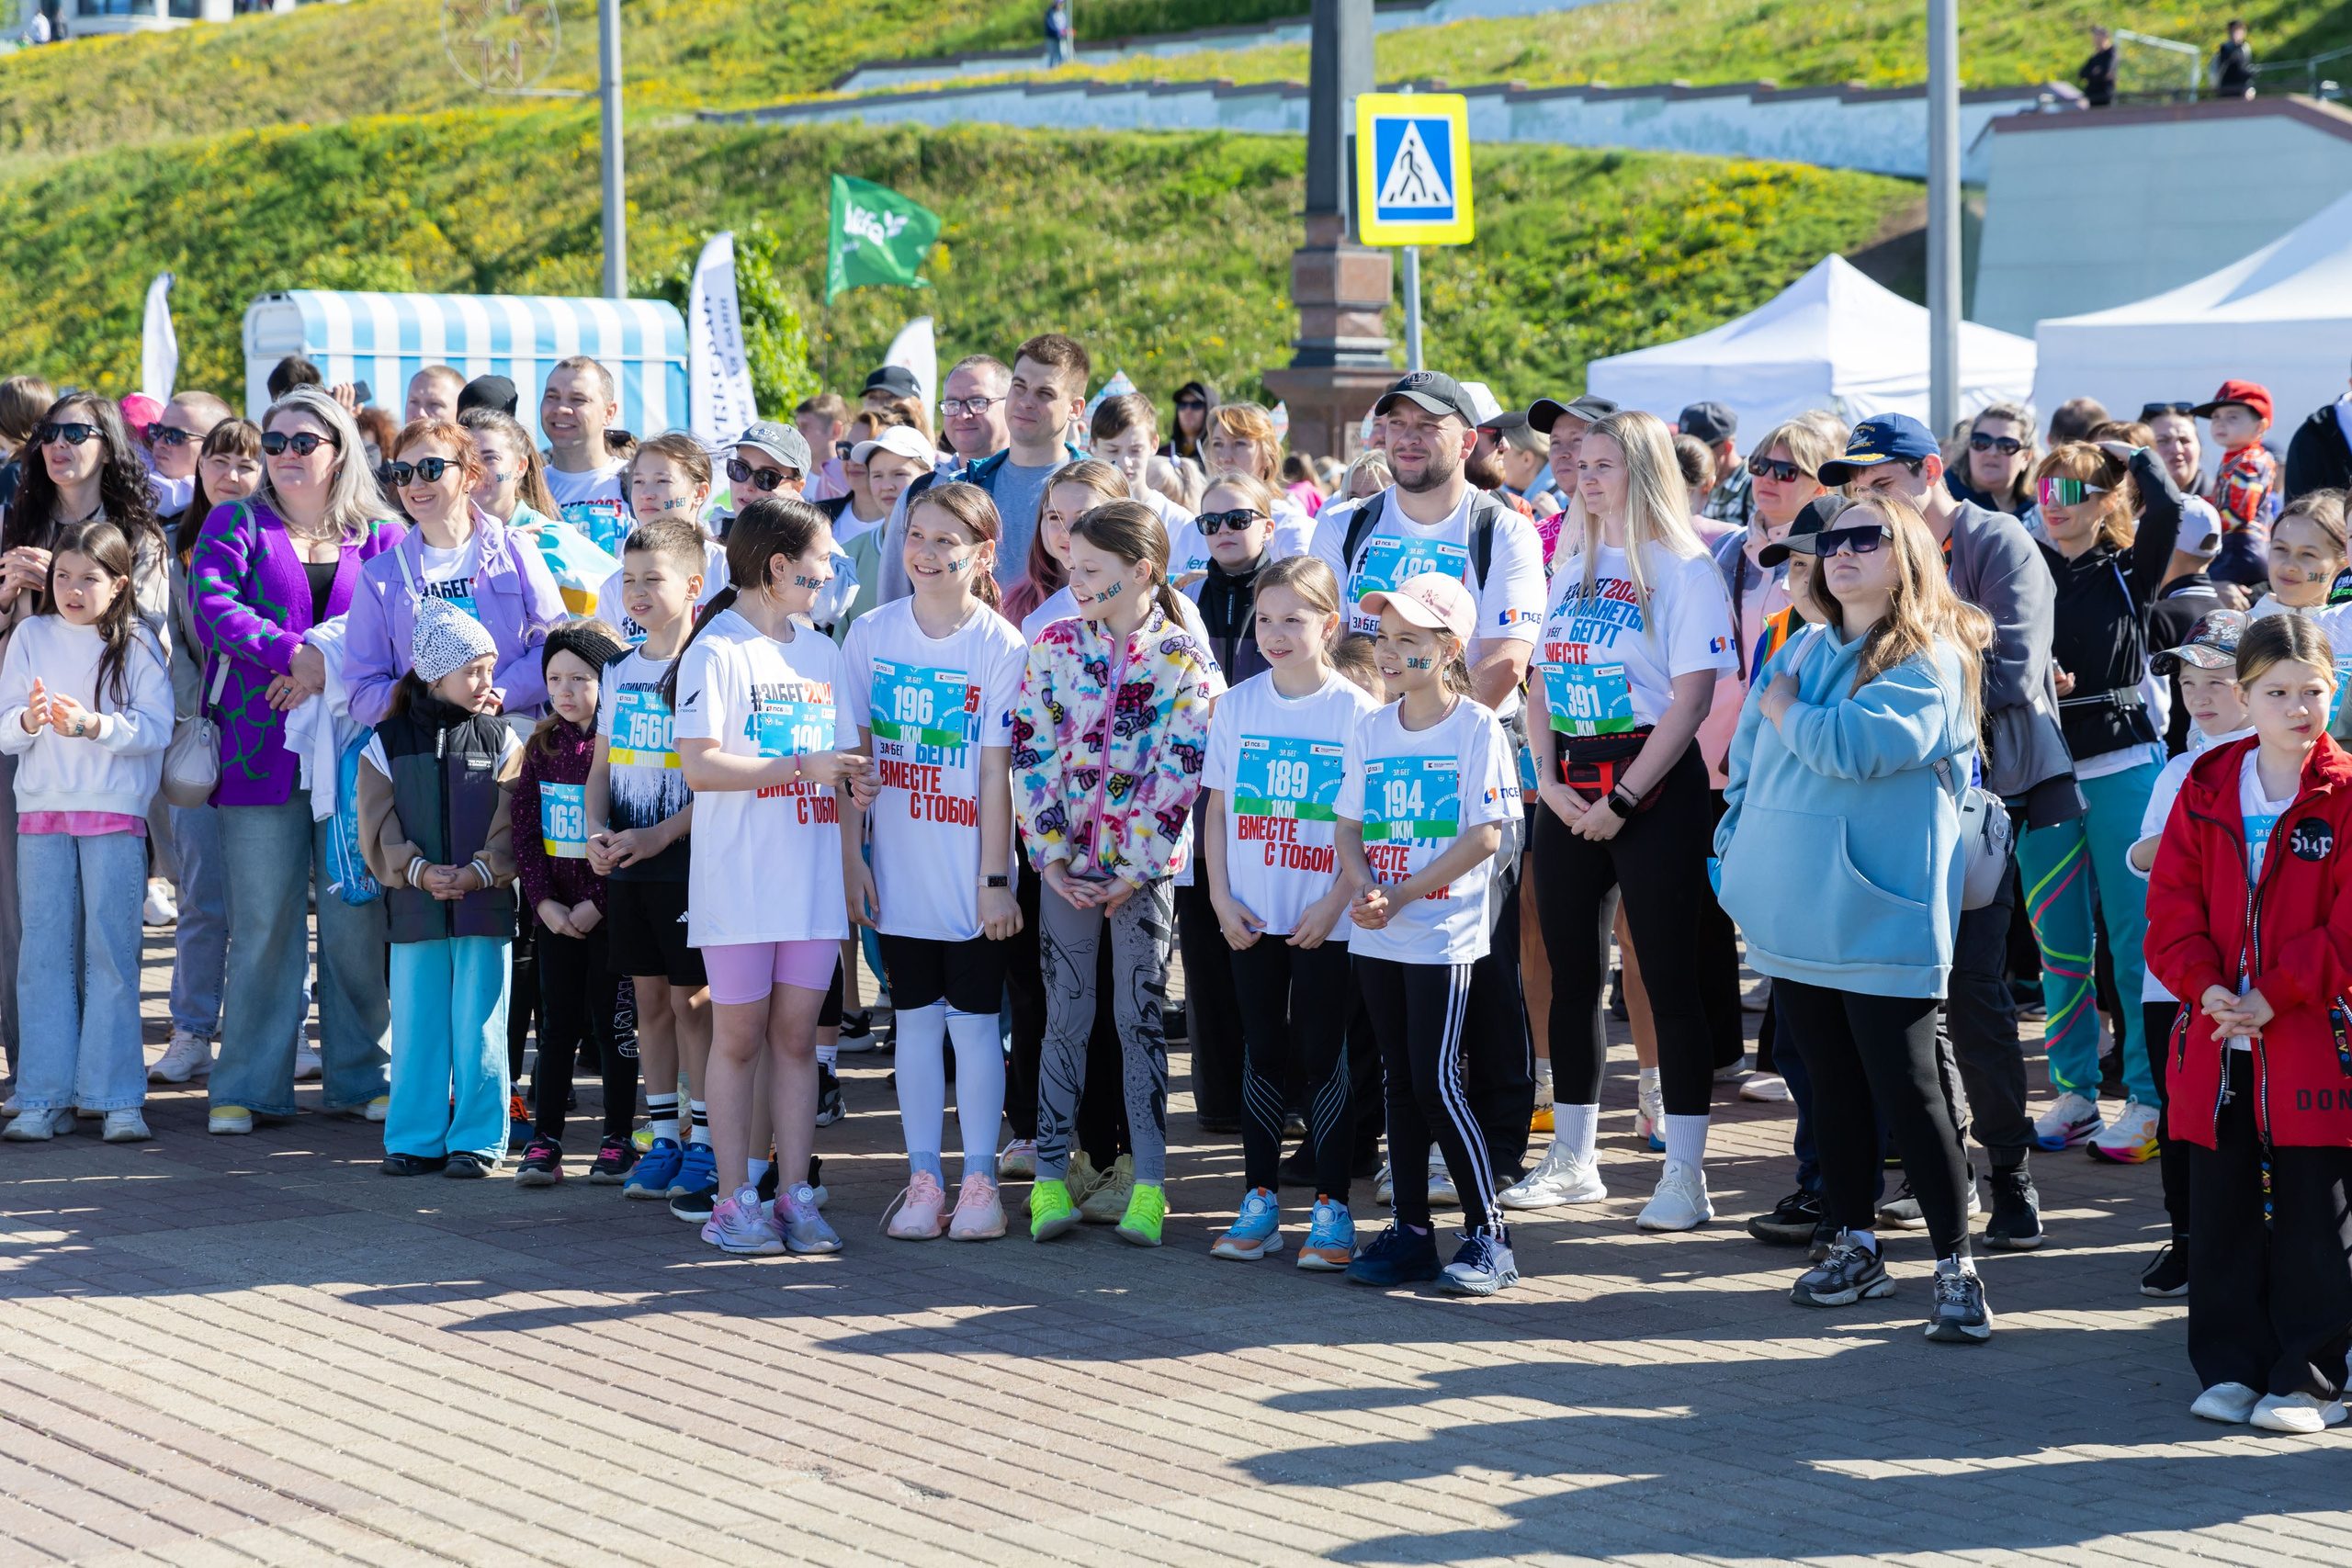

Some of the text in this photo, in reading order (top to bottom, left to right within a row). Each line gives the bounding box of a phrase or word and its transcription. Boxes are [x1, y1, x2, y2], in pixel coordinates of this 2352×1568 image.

[1521, 611, 1542, 625] ПСБ
[1568, 618, 1623, 649] БЕГУТ
[892, 684, 933, 725] 196
[1566, 682, 1602, 718] 391
[628, 712, 675, 750] 1560
[791, 724, 821, 754] 190
[879, 759, 942, 793] ВМЕСТЕ
[1266, 759, 1309, 799] 189
[923, 795, 978, 827] ТОБОЙ
[1383, 779, 1425, 818] 194
[549, 805, 589, 840] 163
[1238, 816, 1298, 842] ВМЕСТЕ
[1280, 843, 1334, 874] ТОБОЙ
